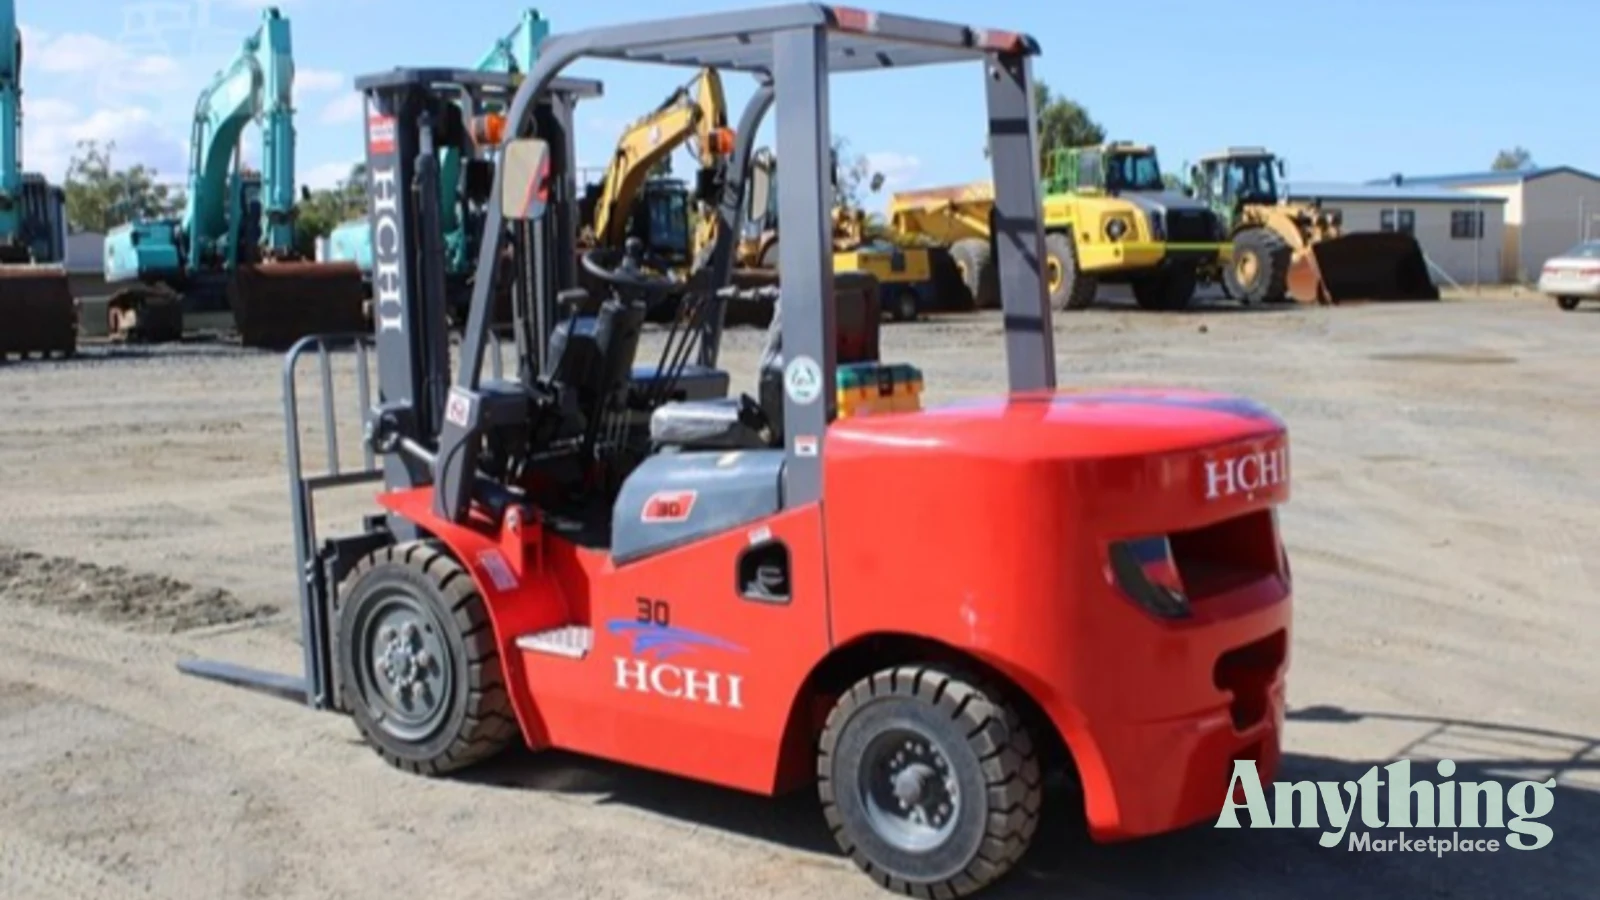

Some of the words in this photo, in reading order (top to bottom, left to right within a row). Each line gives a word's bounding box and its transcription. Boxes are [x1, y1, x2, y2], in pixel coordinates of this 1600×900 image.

[372, 167, 402, 333] HCHI
[636, 598, 670, 626] 30
[613, 656, 744, 709] HCHI
